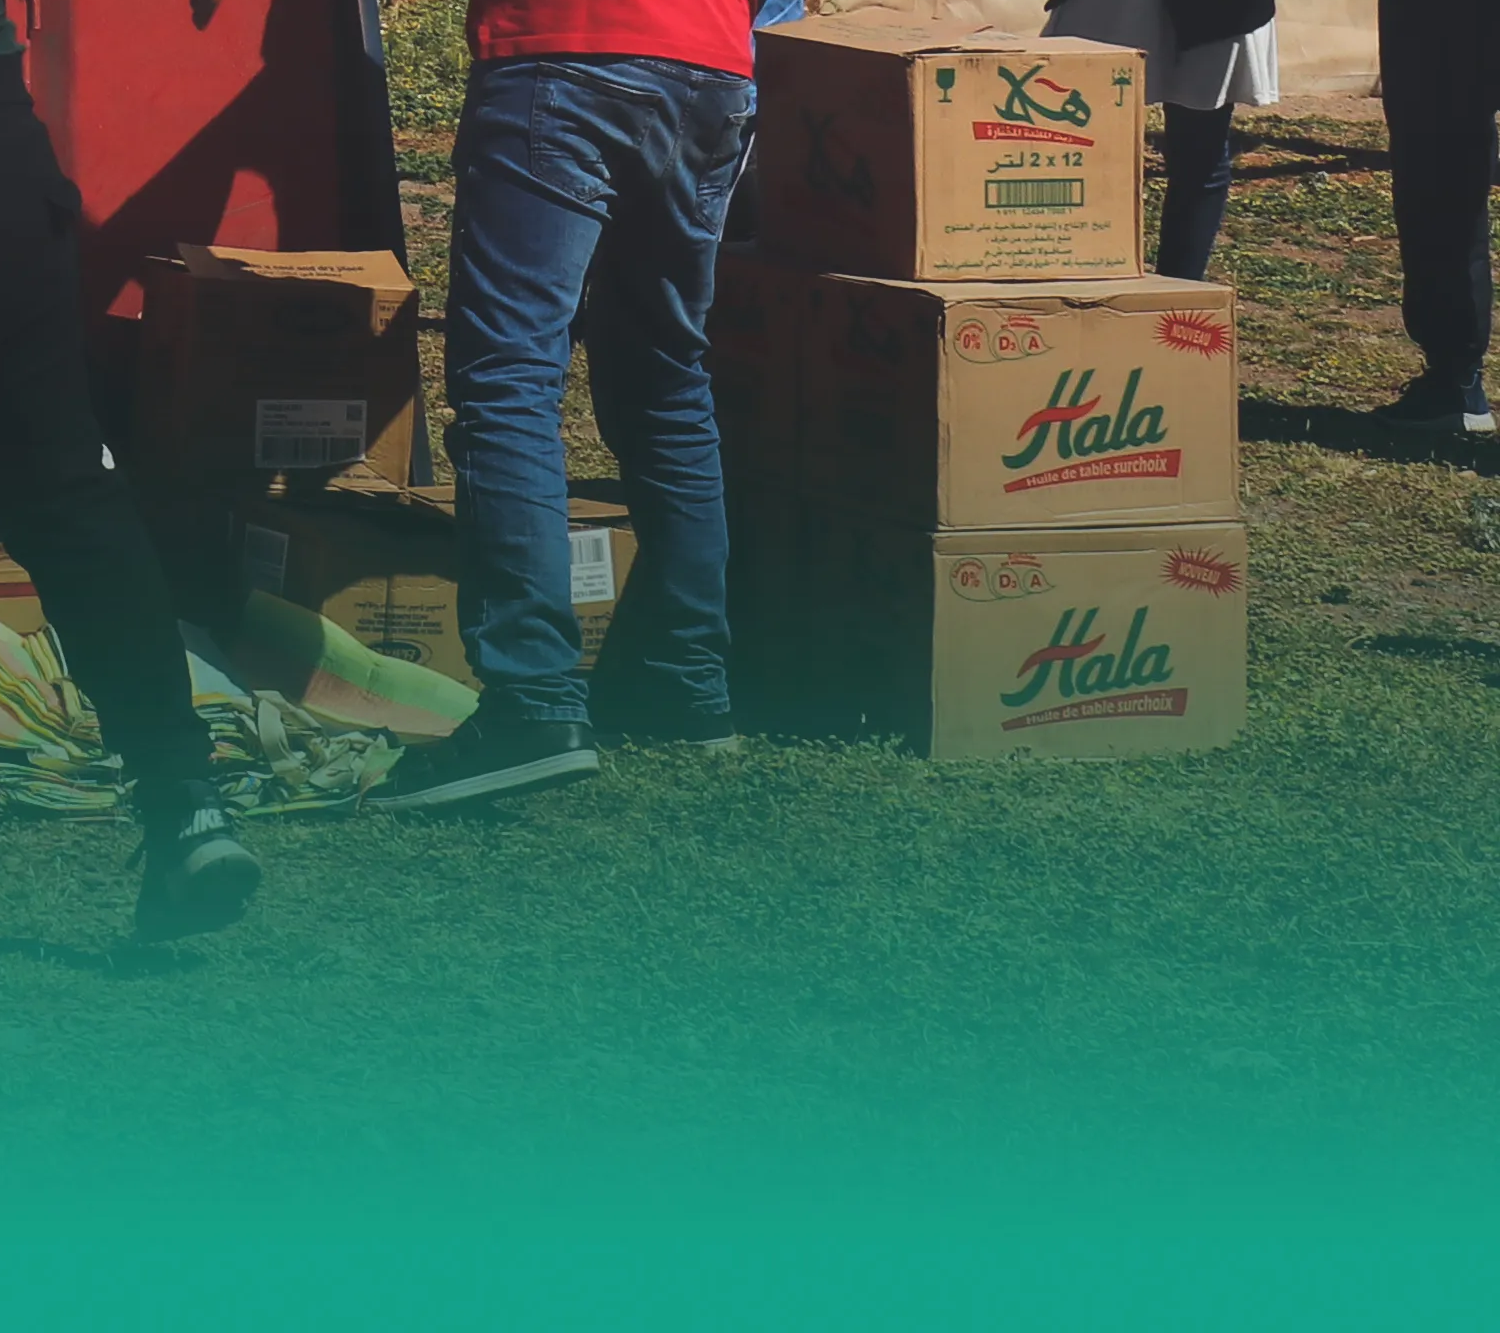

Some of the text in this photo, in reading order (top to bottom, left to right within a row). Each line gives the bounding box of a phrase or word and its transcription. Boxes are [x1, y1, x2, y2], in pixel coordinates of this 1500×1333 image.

[987, 151, 1024, 173] لتر
[1030, 152, 1040, 167] 2
[1062, 152, 1083, 167] 12
[1001, 366, 1169, 470] Hala
[1026, 454, 1169, 487] Huile de table surchoix
[1178, 561, 1222, 585] NOUVEAU
[1000, 605, 1175, 708] Hala
[1062, 705, 1080, 719] de
[1081, 700, 1116, 716] table
[1116, 693, 1174, 713] surchoix
